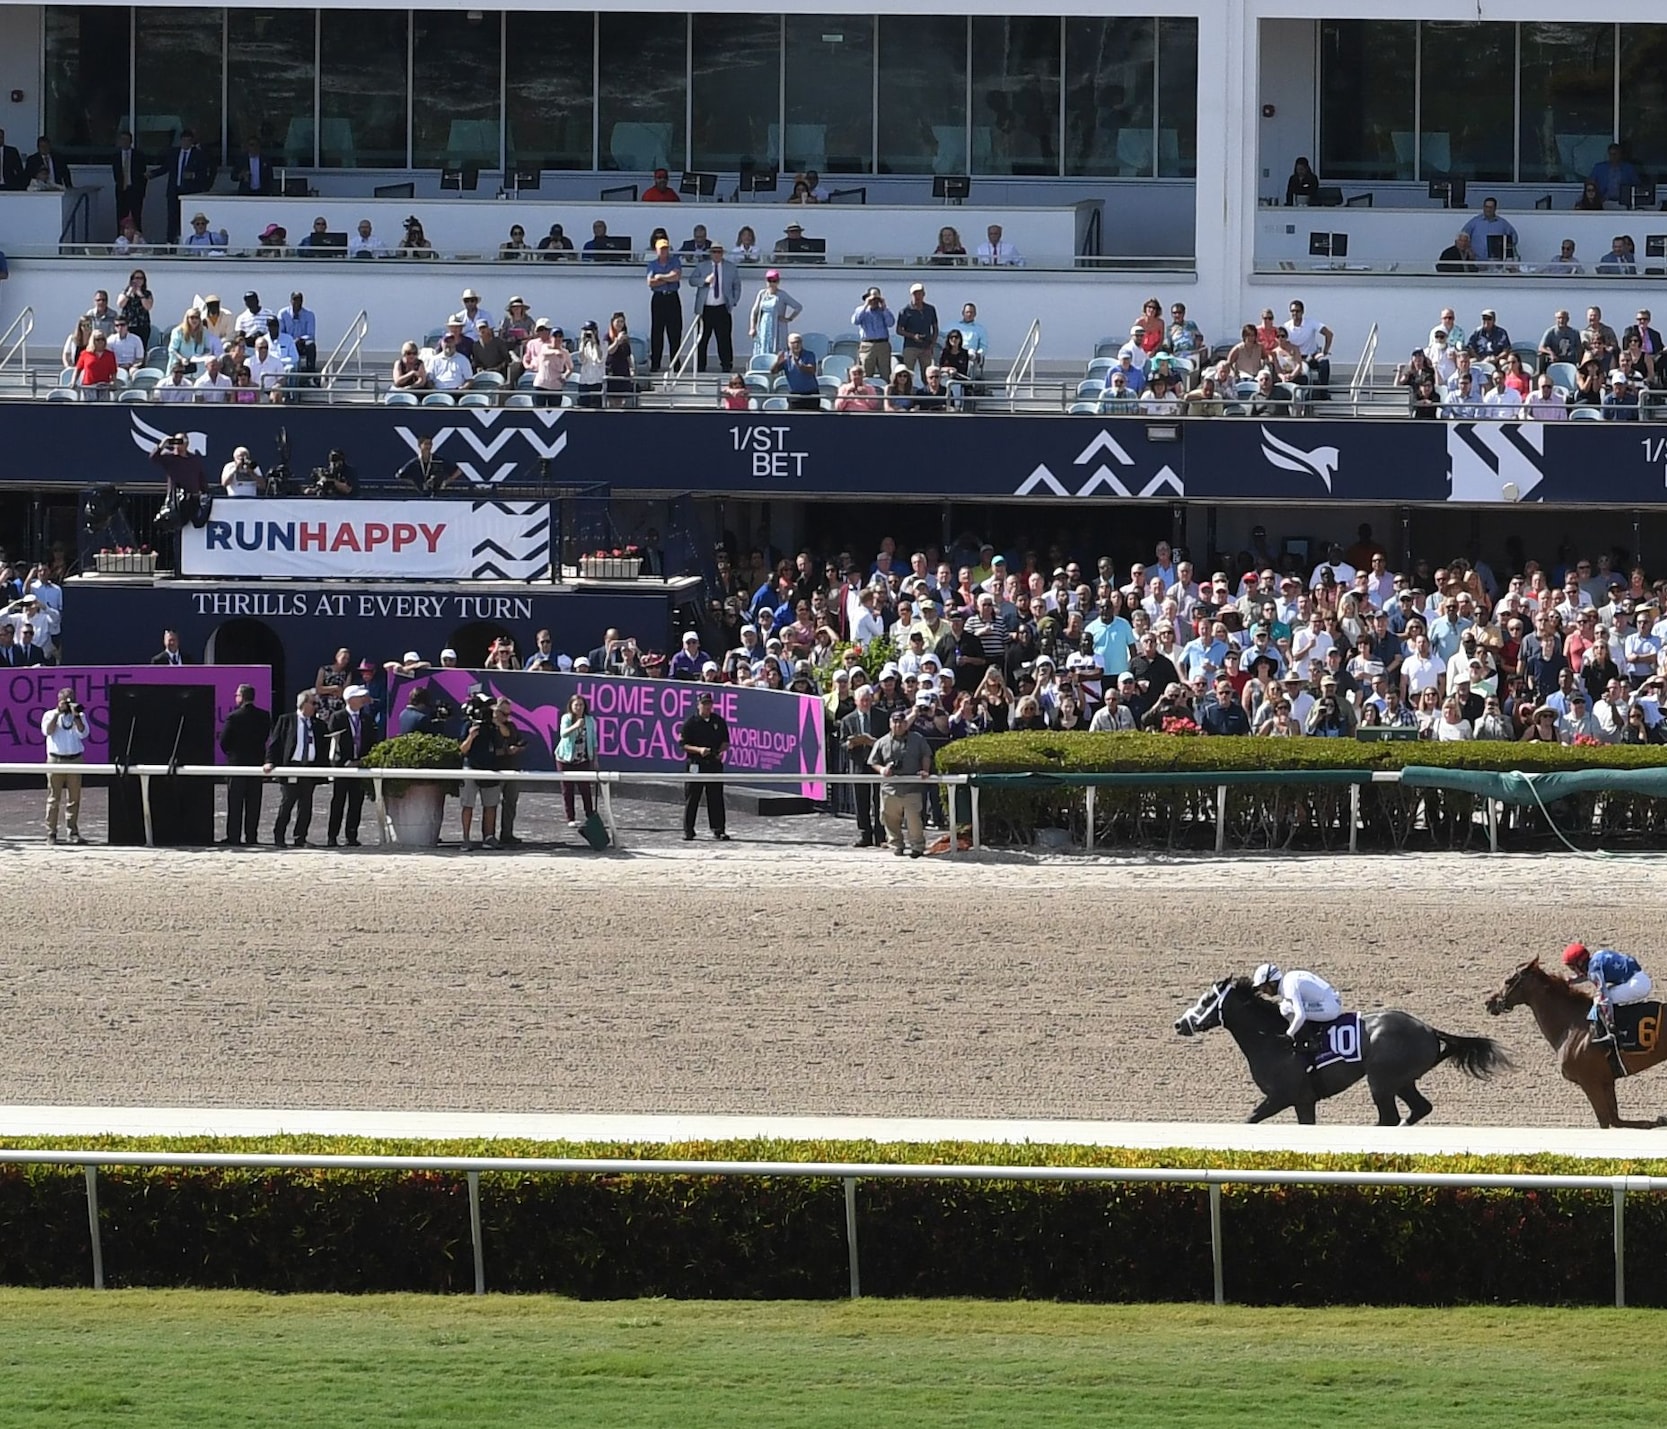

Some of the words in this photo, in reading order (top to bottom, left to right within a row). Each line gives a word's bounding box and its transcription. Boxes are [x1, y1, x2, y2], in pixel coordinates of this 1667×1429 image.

[730, 426, 792, 452] 1/ST
[753, 451, 809, 477] BET
[206, 521, 447, 553] RUNHAPPY
[192, 593, 307, 616] THRILLS
[314, 595, 352, 617] AT
[359, 595, 448, 618] EVERY
[454, 596, 533, 620] TURN
[9, 675, 56, 703] OF
[577, 682, 655, 716] HOME
[660, 687, 692, 718] OF
[728, 726, 772, 750] WORLD
[773, 732, 797, 754] CUP
[1327, 1024, 1356, 1056] 10
[1638, 1016, 1657, 1048] 6
